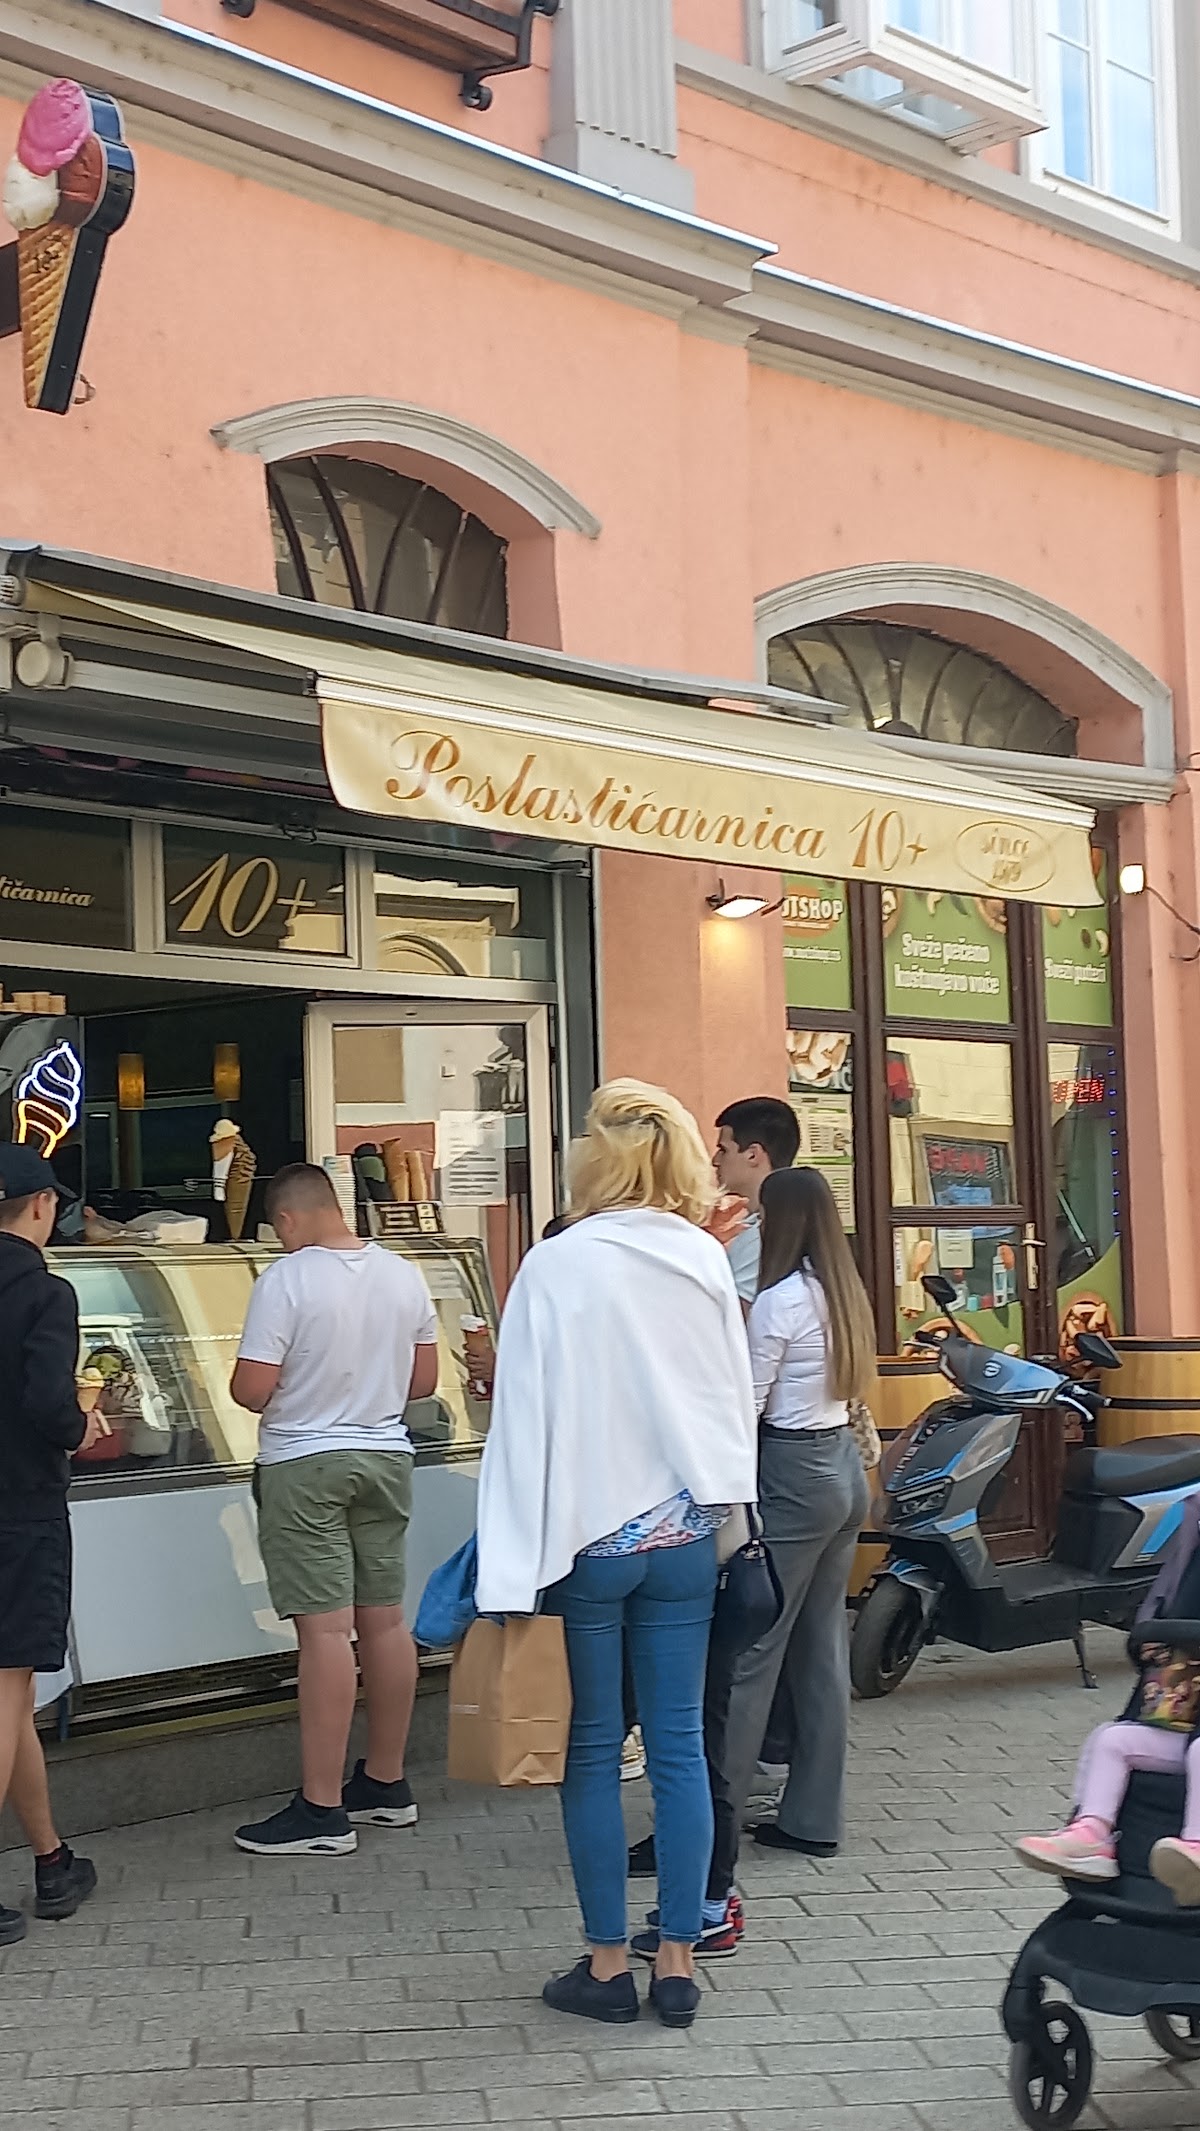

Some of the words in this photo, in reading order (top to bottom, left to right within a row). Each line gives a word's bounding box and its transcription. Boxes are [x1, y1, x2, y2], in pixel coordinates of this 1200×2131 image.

[385, 730, 828, 859] Poslastićarnica
[849, 808, 929, 872] 10+
[169, 852, 317, 938] 10+
[1053, 1078, 1105, 1103] OPEN
